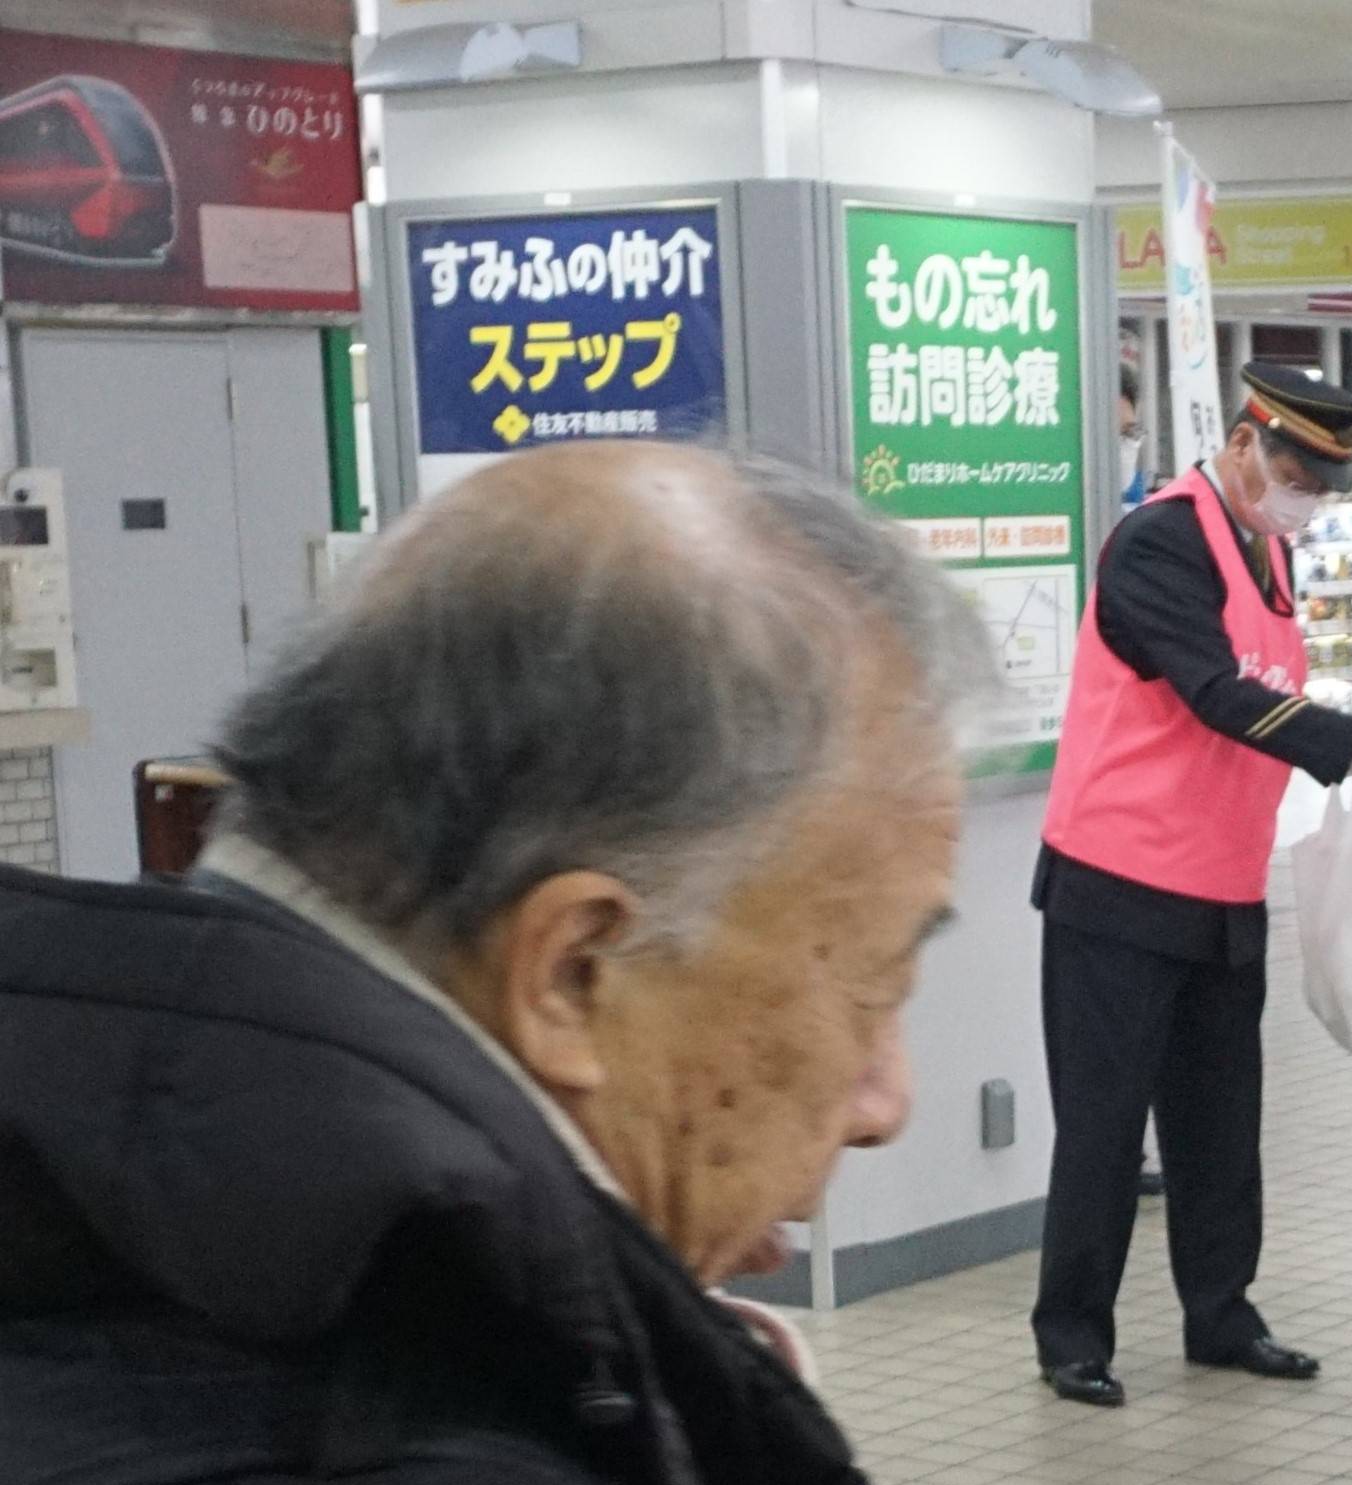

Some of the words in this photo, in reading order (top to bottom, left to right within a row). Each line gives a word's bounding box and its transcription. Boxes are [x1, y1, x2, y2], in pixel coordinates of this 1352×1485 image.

[423, 228, 712, 305] すみふの仲介
[1119, 226, 1227, 269] LAA
[865, 244, 1057, 334] もの忘れ
[470, 312, 681, 393] ステップ
[867, 343, 1061, 426] 訪問診療
